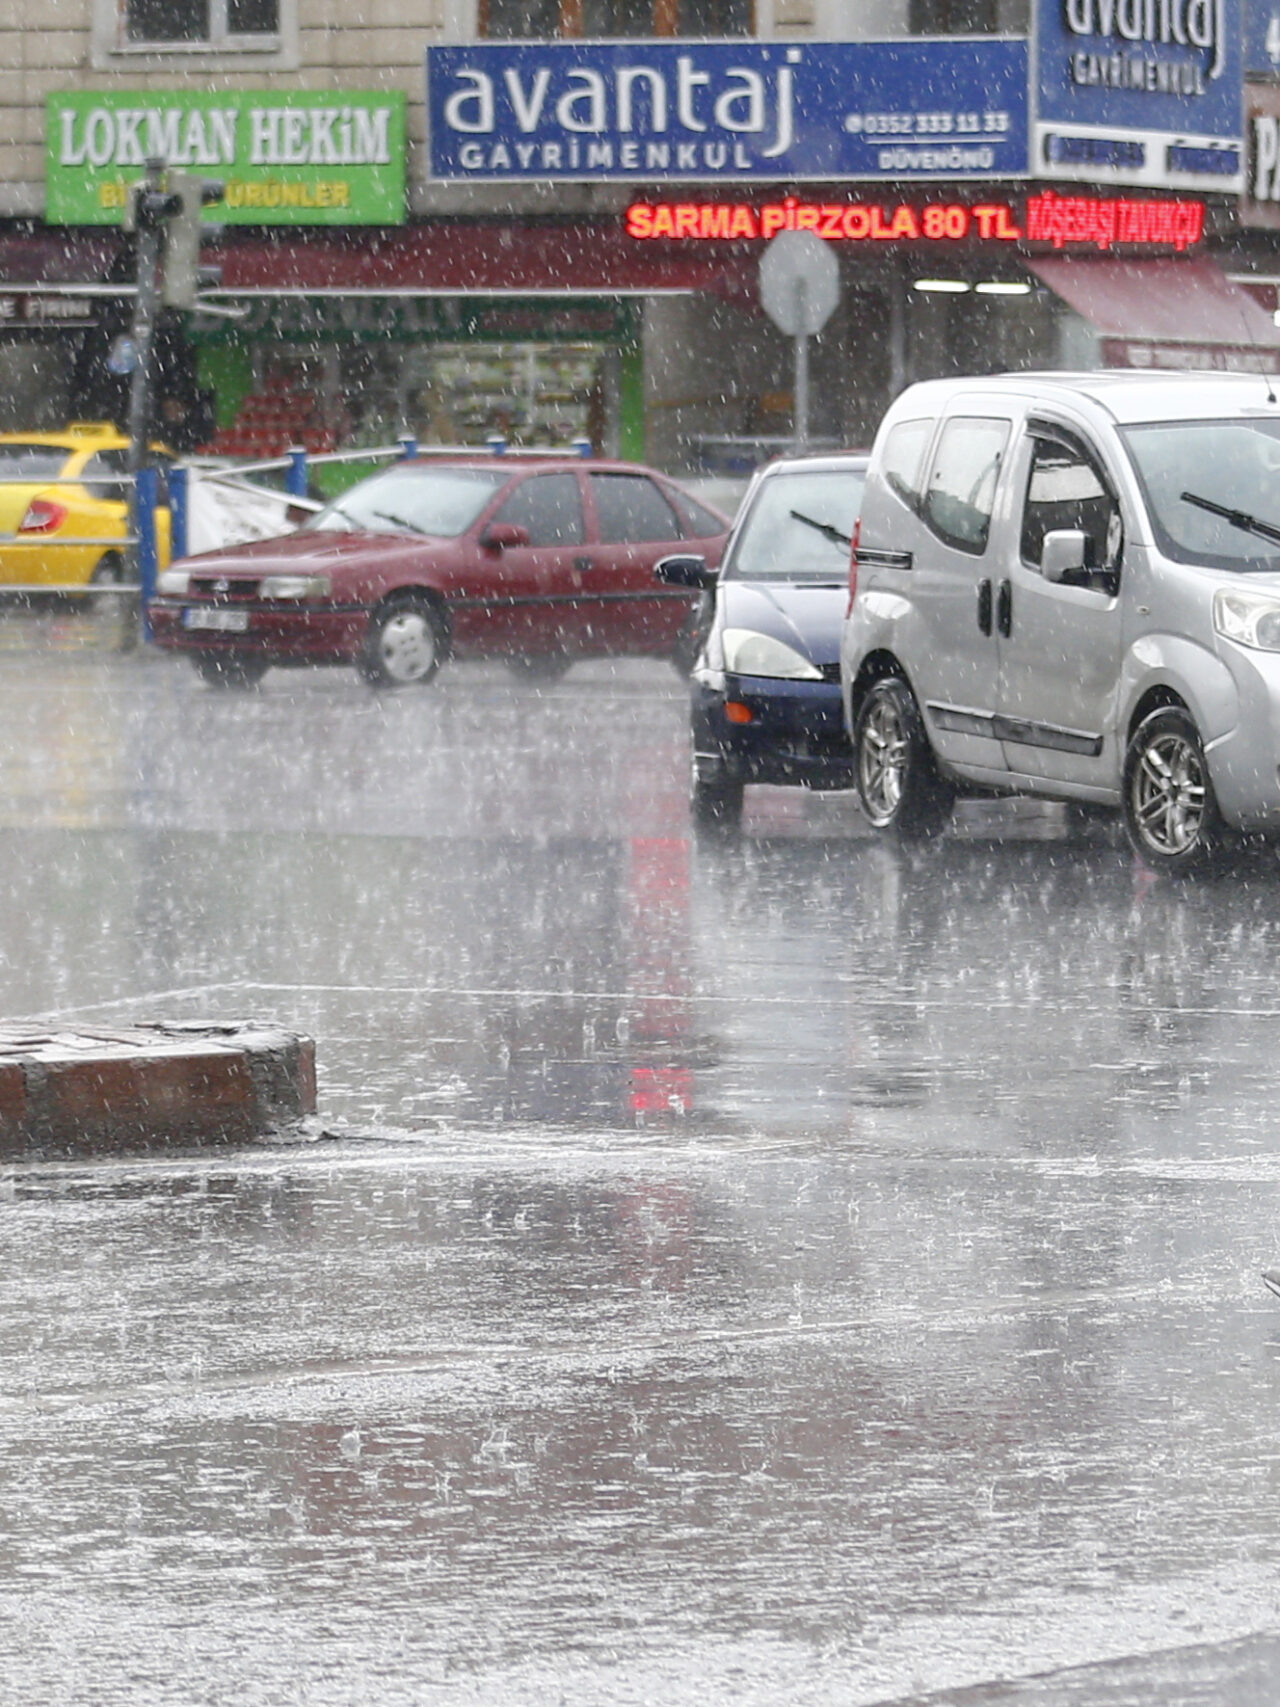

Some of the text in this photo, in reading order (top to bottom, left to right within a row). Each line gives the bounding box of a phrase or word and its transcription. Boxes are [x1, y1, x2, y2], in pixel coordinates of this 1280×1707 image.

[445, 48, 801, 158] avantaj
[59, 108, 239, 166] LOKMAN
[863, 114, 914, 133] 0352
[460, 140, 752, 170] GAYRİMENKUL
[878, 147, 994, 170] DÜVENÖNÜ
[226, 178, 349, 208] ÜRÜNLER
[627, 203, 754, 240] SARMA
[922, 205, 966, 240] 80
[974, 206, 1022, 240] TL
